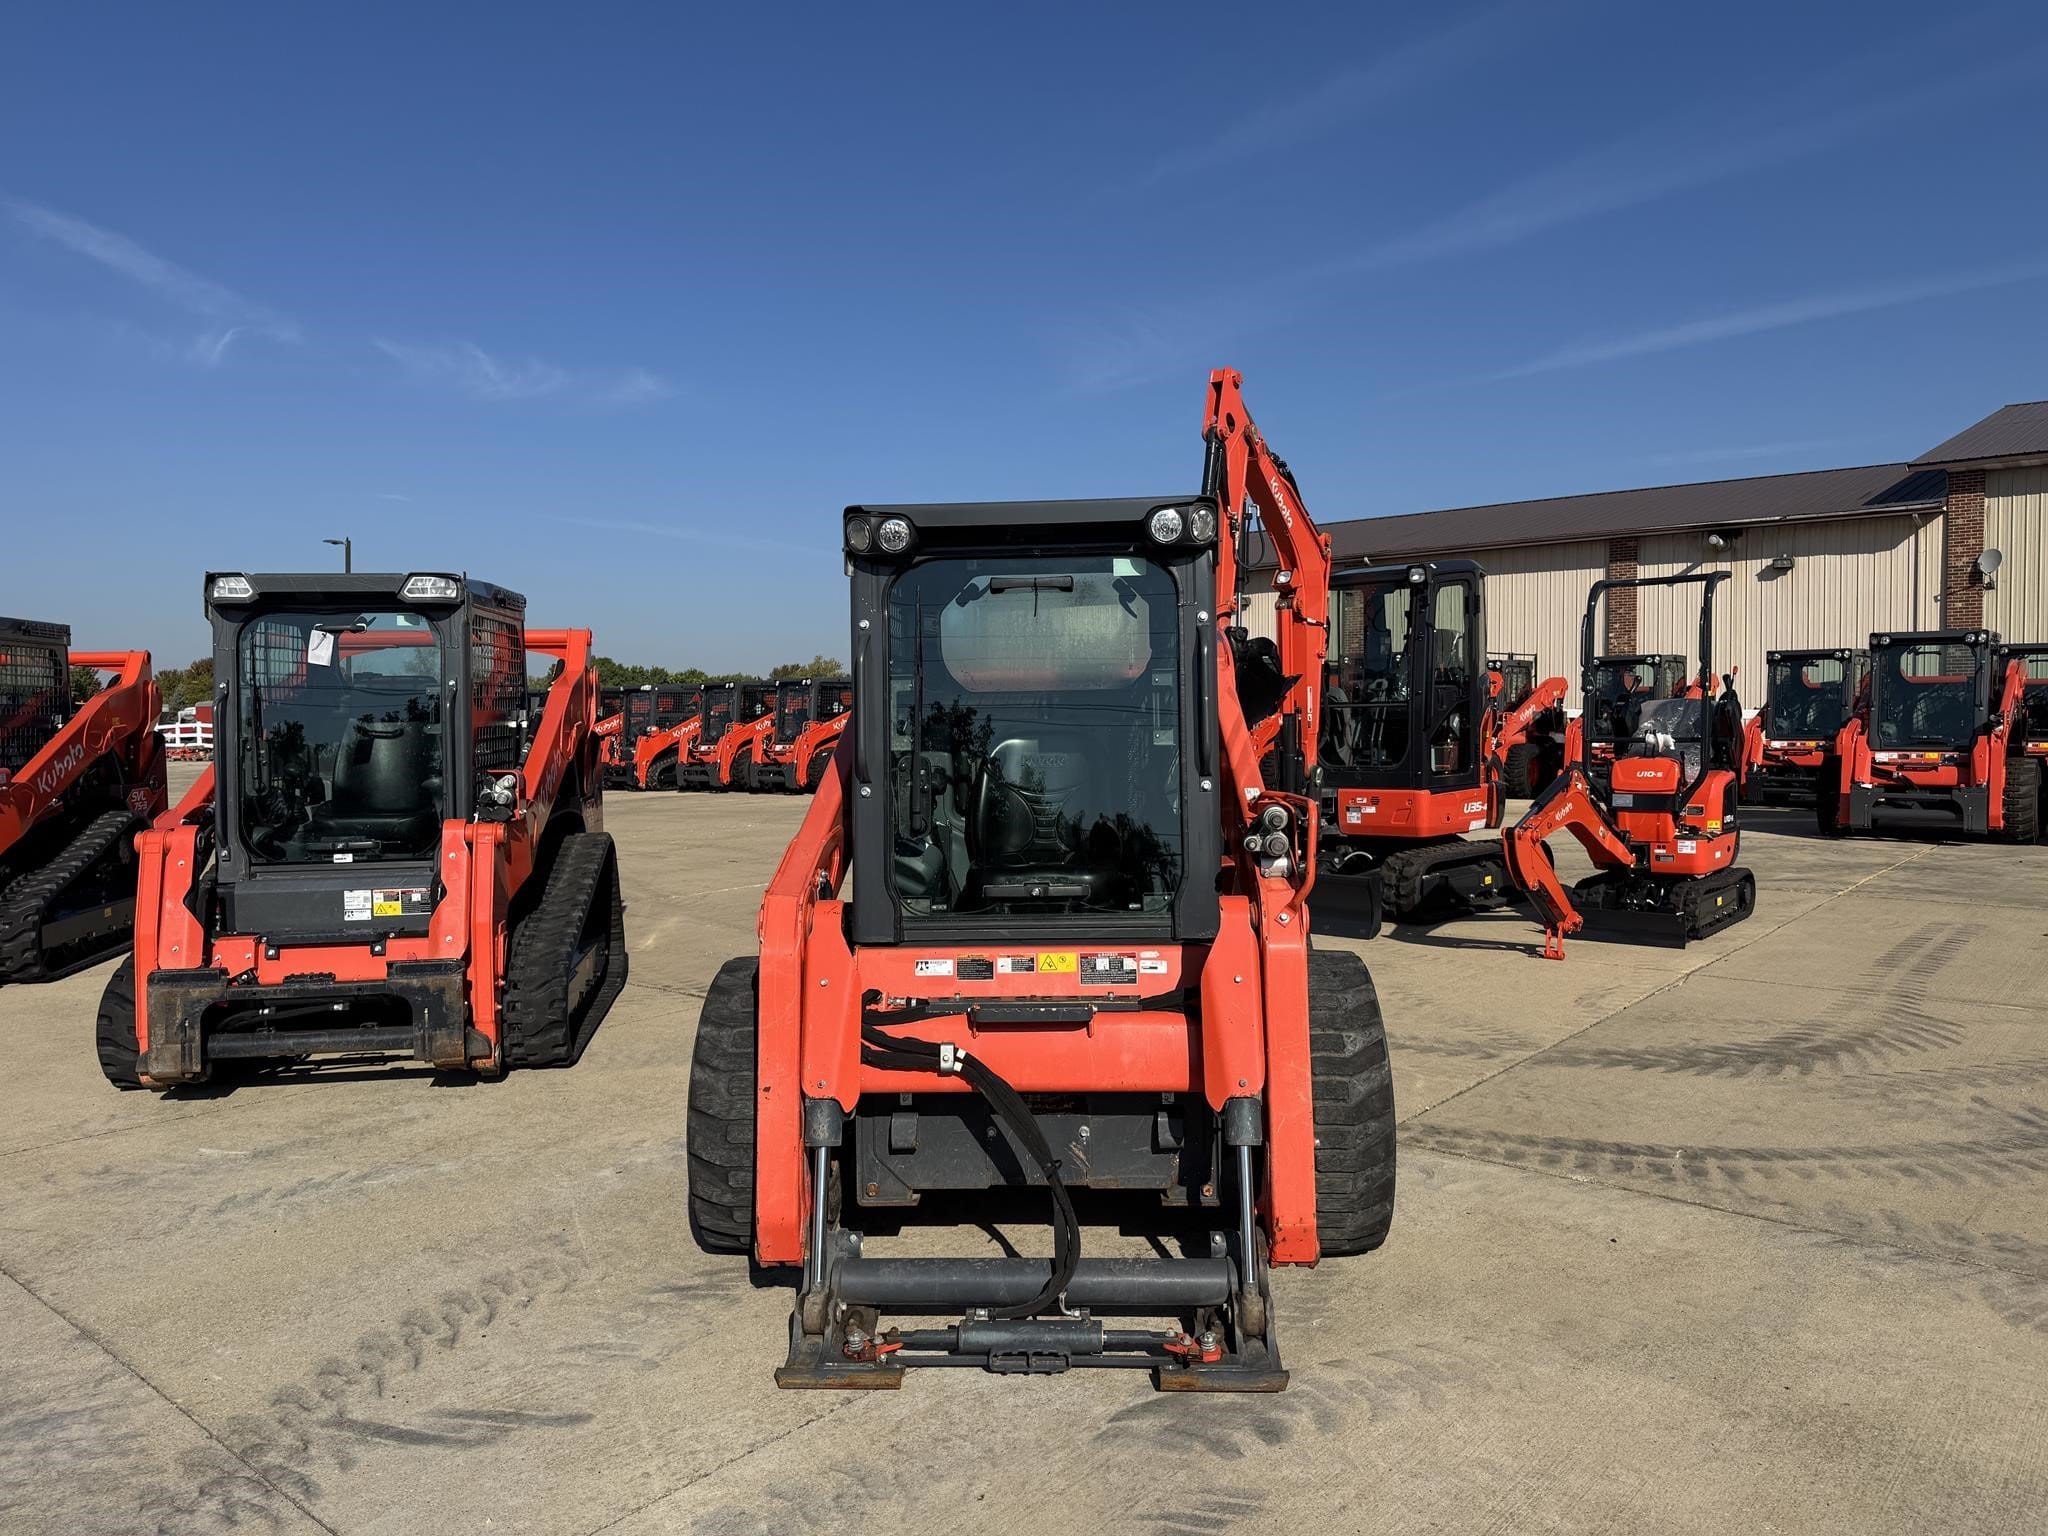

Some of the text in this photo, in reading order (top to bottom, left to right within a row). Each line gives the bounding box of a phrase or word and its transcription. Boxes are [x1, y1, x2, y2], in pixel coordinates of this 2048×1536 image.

[1271, 476, 1293, 528] Kubota
[672, 722, 699, 738] Kubota
[755, 719, 771, 731] Kub
[37, 743, 85, 794] Kubota
[1555, 802, 1573, 821] Kubota
